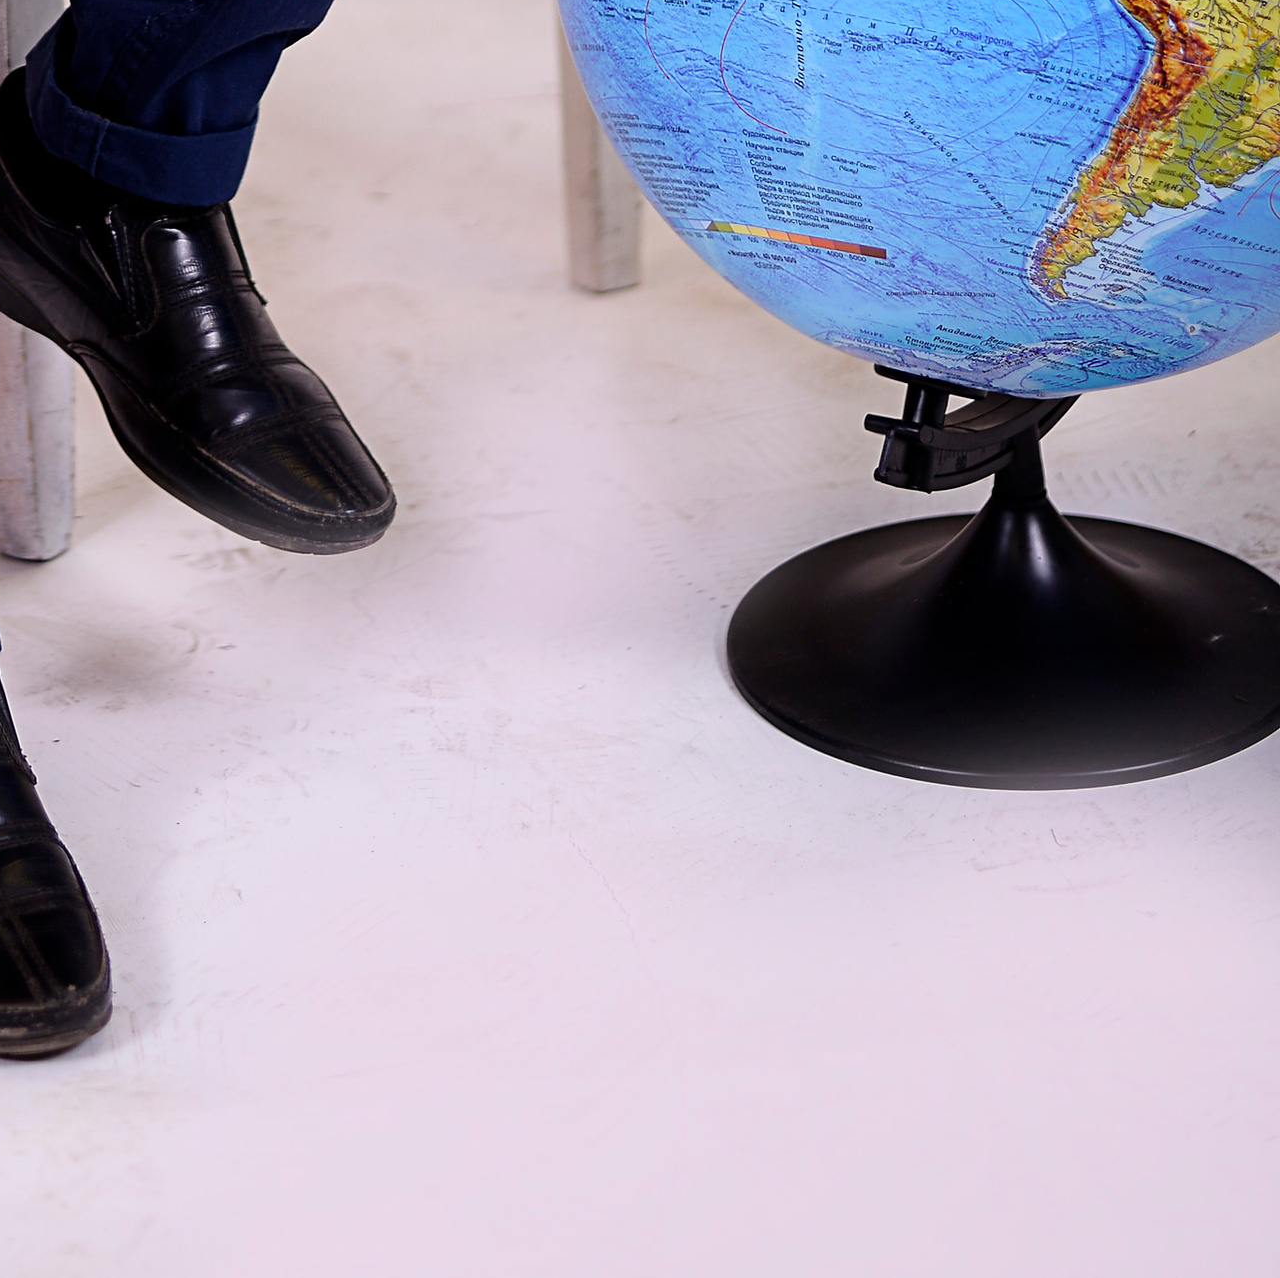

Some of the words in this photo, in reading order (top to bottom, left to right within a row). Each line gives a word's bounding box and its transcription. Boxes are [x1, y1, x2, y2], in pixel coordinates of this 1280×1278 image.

[949, 26, 982, 42] Южный
[983, 32, 1014, 48] тропик
[1041, 59, 1111, 84] Чилийская
[1027, 92, 1100, 115] котловина
[744, 140, 776, 154] Научные
[776, 145, 805, 158] станции
[782, 135, 811, 147] каналы
[746, 150, 773, 162] Болота
[903, 110, 958, 164] Чилийское
[966, 171, 1014, 221] поднятие
[1120, 171, 1186, 195] АРГЕНТИНА
[811, 190, 863, 207] наибольшего
[826, 250, 844, 259] 4000
[848, 253, 867, 263] 5000
[1098, 263, 1132, 278] Острова
[1175, 254, 1244, 280] котловина
[936, 324, 983, 340] Академик
